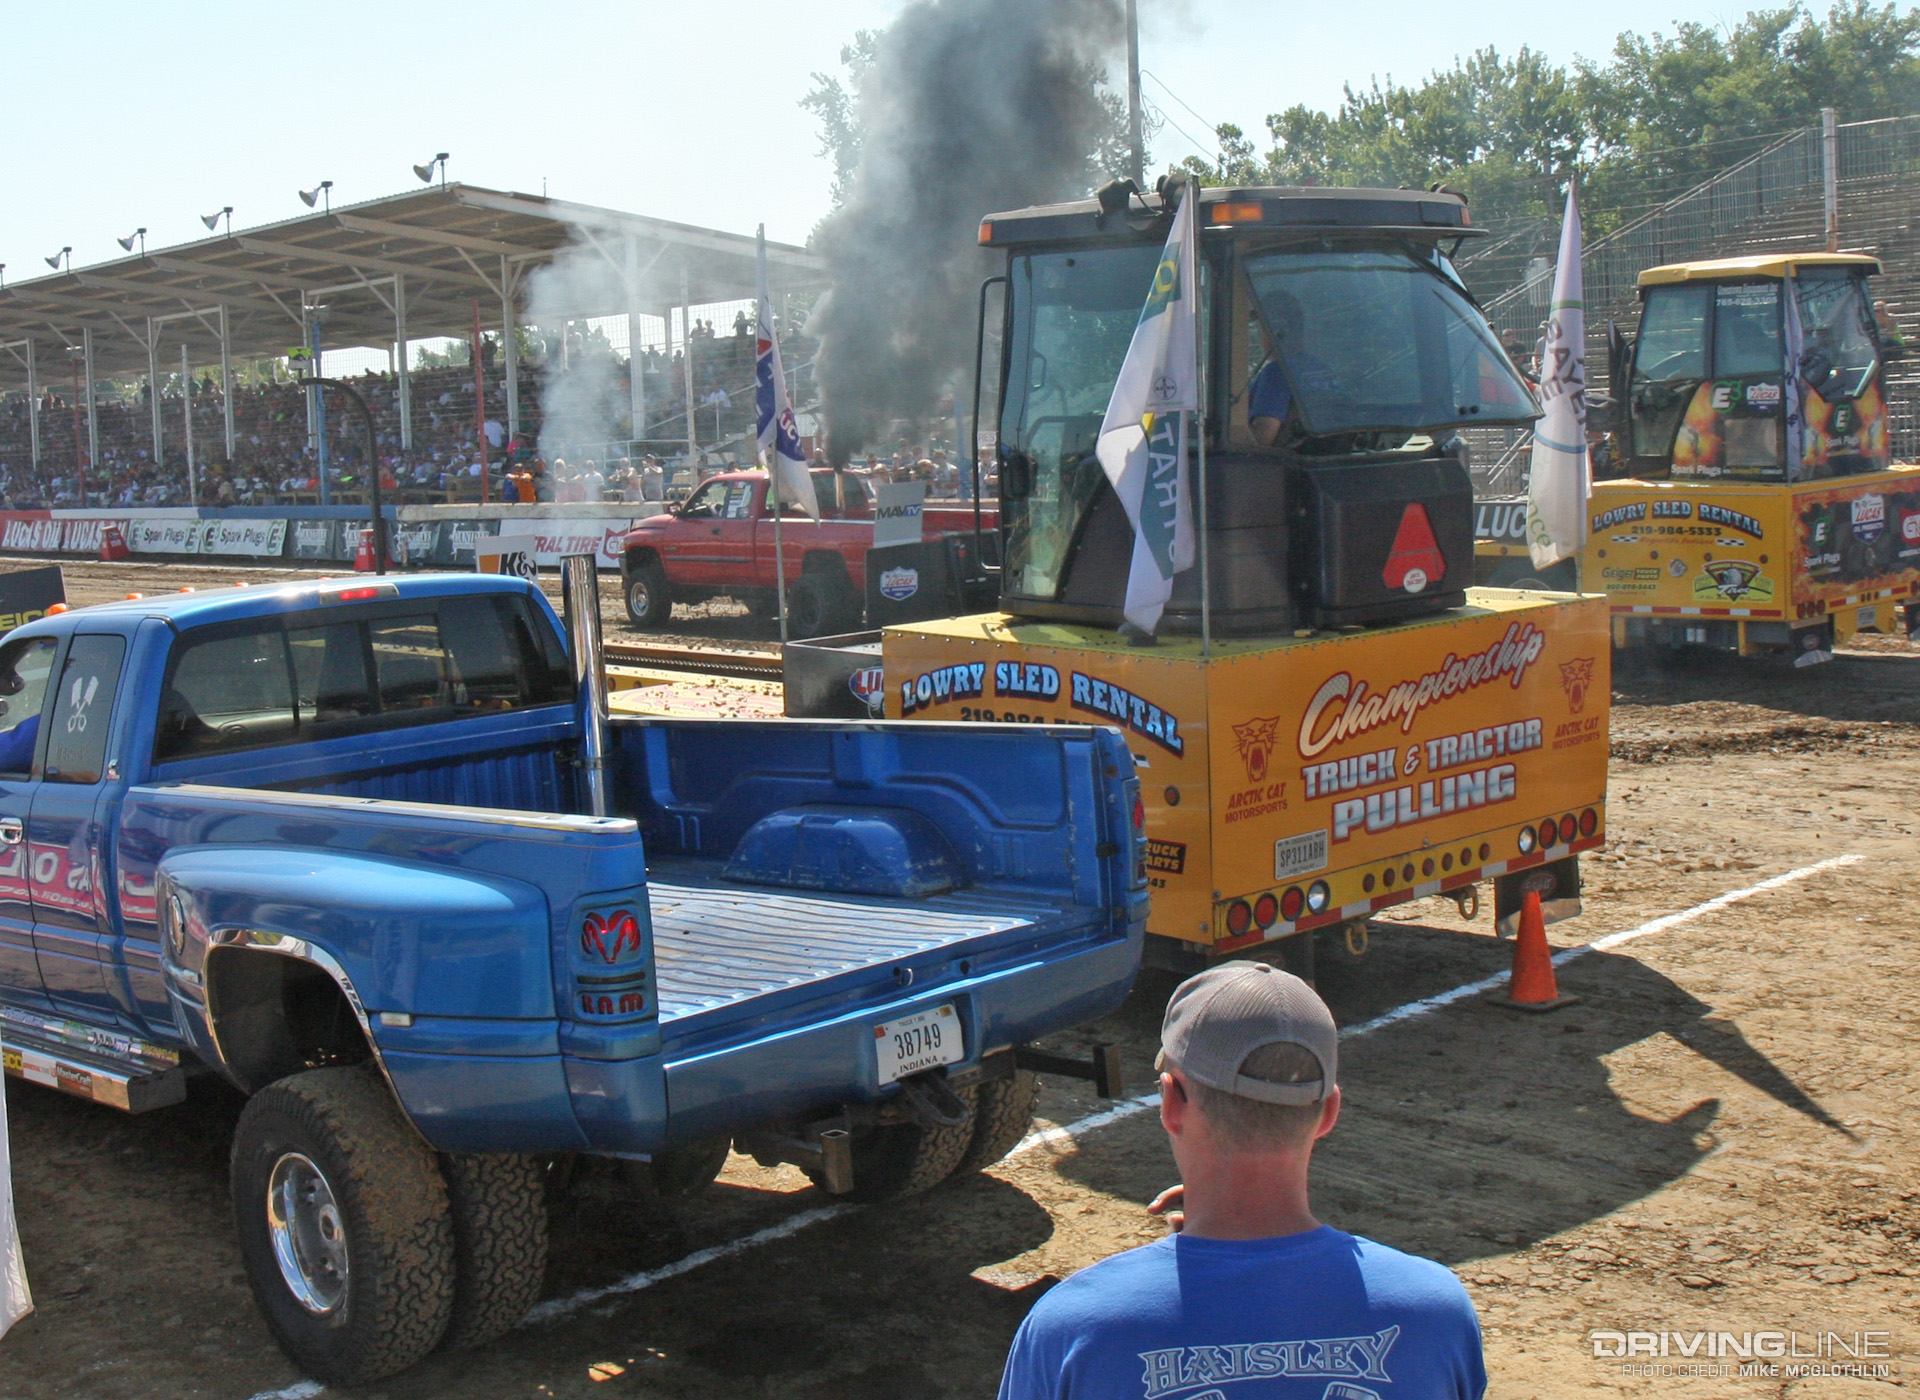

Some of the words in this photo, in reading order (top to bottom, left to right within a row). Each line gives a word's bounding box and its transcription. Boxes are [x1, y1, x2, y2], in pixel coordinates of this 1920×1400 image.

[1671, 464, 1695, 474] Spark
[1696, 465, 1721, 477] Plugs
[1593, 503, 1646, 532] LOWRY
[1653, 501, 1692, 518] SLED
[1699, 503, 1763, 538] RENTAL
[1631, 526, 1722, 537] 219-984-5333
[2, 521, 41, 548] LUCAS
[565, 536, 602, 553] TIRE
[1602, 567, 1634, 580] Geiger
[1299, 623, 1543, 757] Championship
[902, 663, 985, 716] LOWRY
[995, 661, 1060, 700] SLED
[1071, 671, 1184, 758] RENTAL
[1302, 748, 1397, 799] TRUCK
[1404, 745, 1419, 775] &
[1425, 718, 1543, 770] TRACTOR
[1228, 788, 1263, 809] ARCTIC
[1267, 782, 1286, 800] CAT
[1332, 764, 1516, 840] PULLING
[1225, 799, 1288, 823] MOTORSPORTS
[894, 1023, 941, 1059] 38749
[56, 1065, 91, 1086] MasterCraft
[900, 1055, 938, 1073] INDIANA
[1138, 1325, 1399, 1398] HAISLEY
